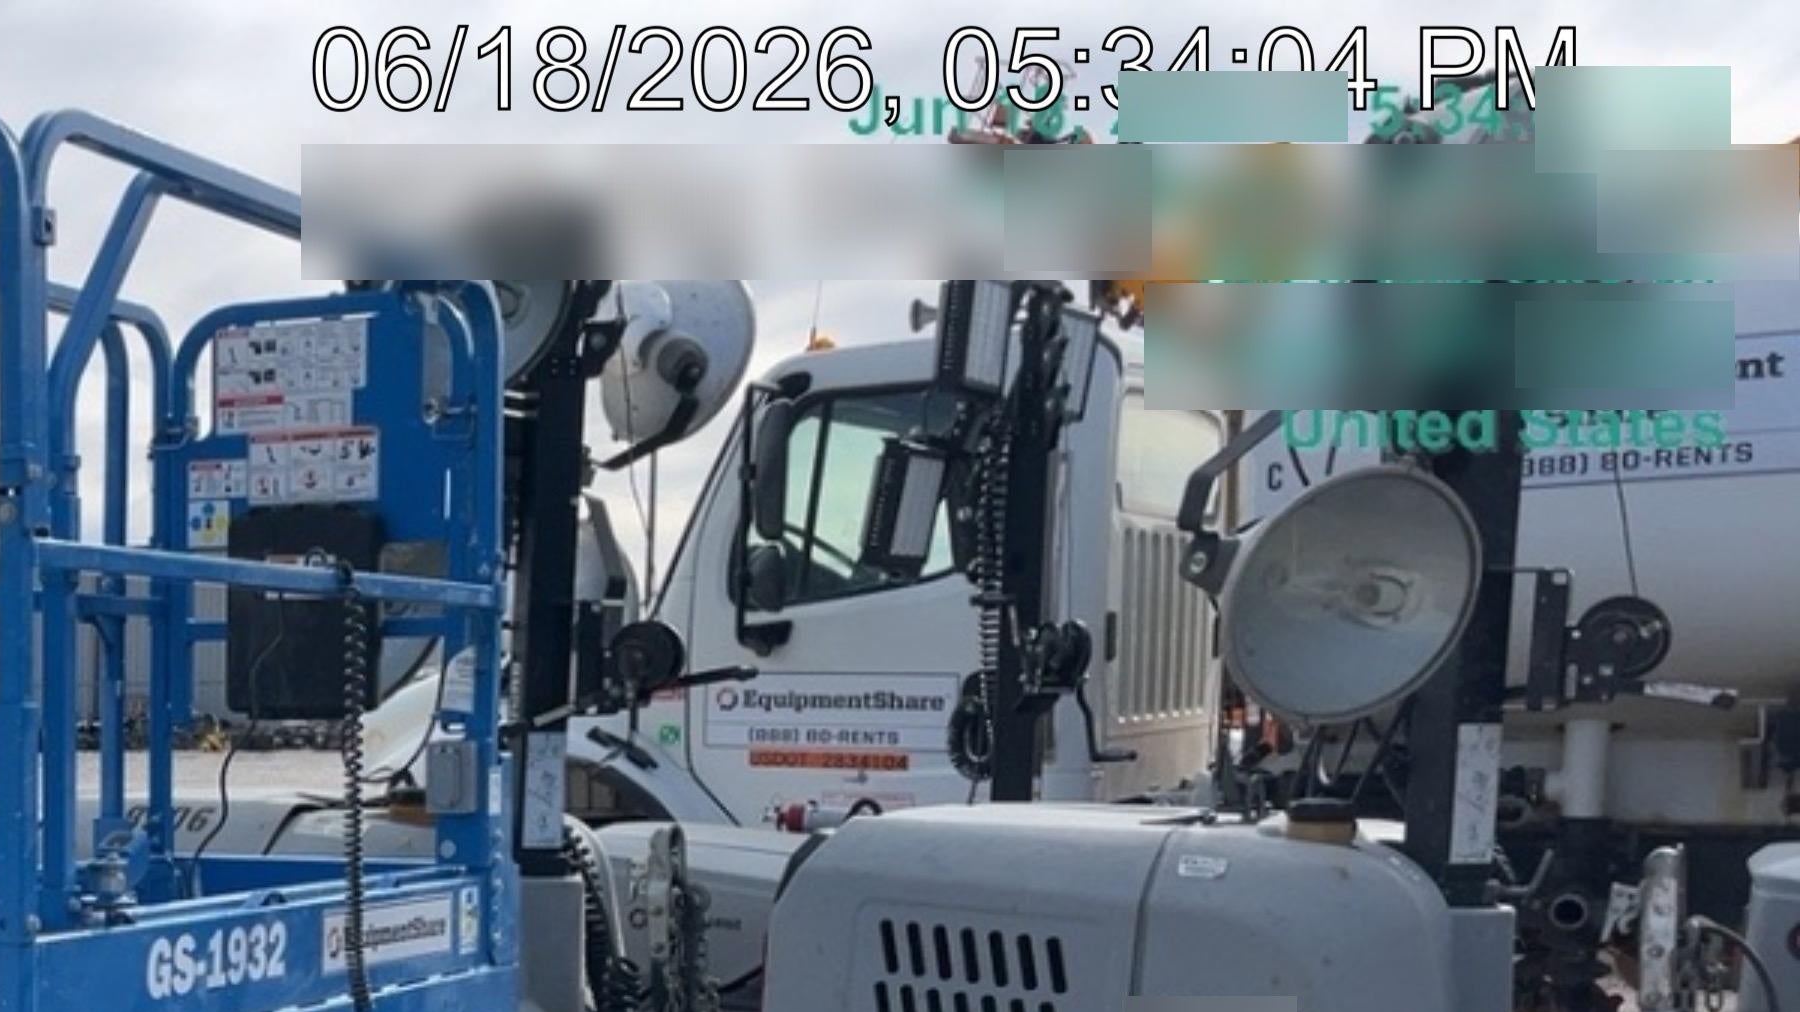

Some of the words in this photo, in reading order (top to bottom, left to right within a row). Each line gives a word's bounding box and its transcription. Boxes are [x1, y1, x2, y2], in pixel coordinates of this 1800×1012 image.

[1600, 441, 1754, 472] 80-RENTS
[743, 688, 946, 713] EquipmentShare
[147, 920, 287, 1000] GS-1932
